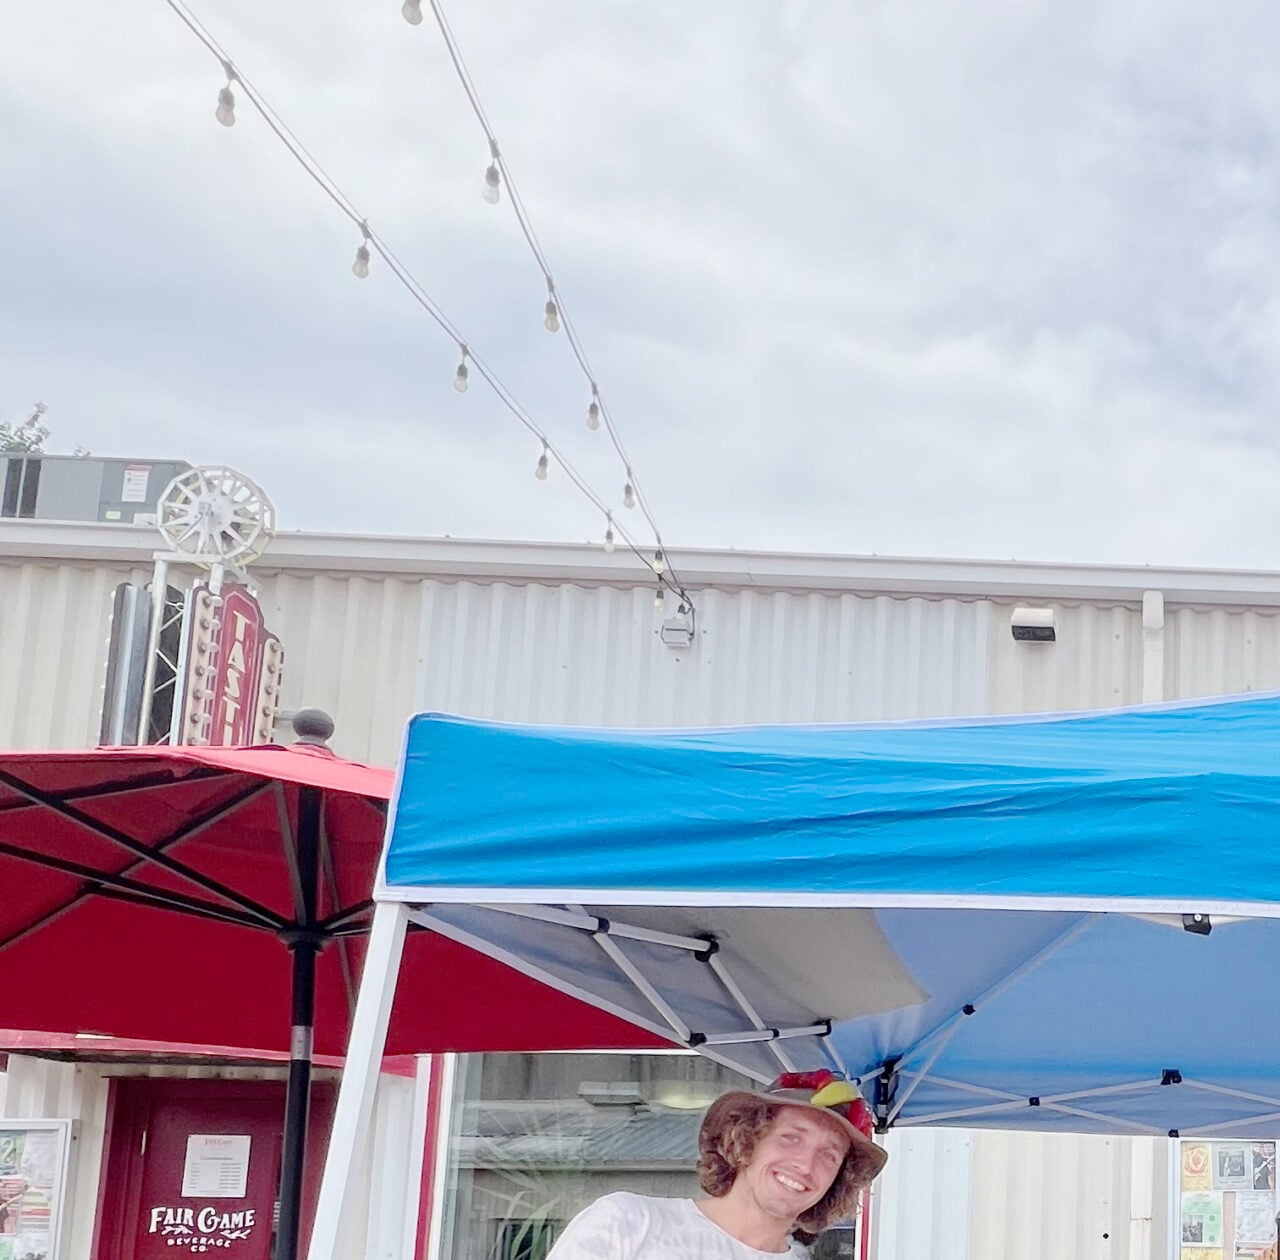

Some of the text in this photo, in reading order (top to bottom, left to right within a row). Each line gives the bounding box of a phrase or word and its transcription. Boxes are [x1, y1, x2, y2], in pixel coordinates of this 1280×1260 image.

[148, 1206, 256, 1233] FAIR GAME
[167, 1237, 231, 1248] BEVERAGE
